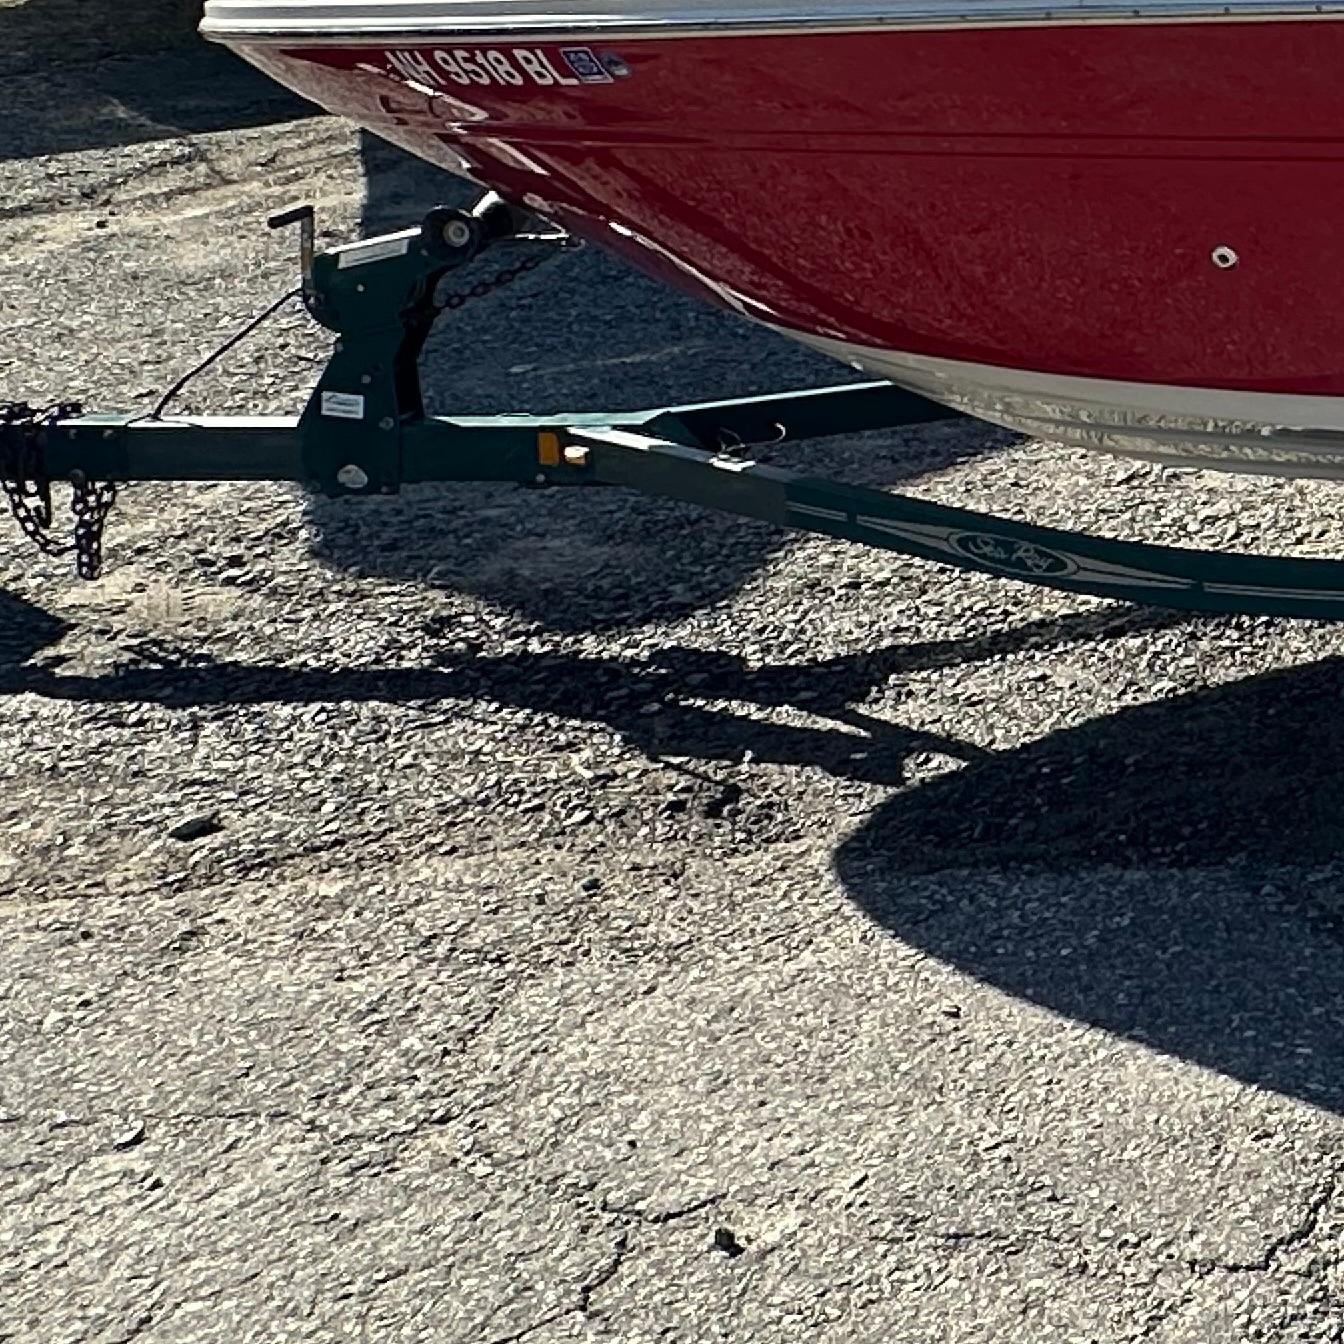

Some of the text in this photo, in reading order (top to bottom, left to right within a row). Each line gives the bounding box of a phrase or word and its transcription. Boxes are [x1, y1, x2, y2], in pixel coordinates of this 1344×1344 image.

[384, 50, 448, 87] NH
[433, 48, 525, 86] 9518
[512, 48, 581, 86] BL
[968, 535, 1056, 574] Sea Ray
